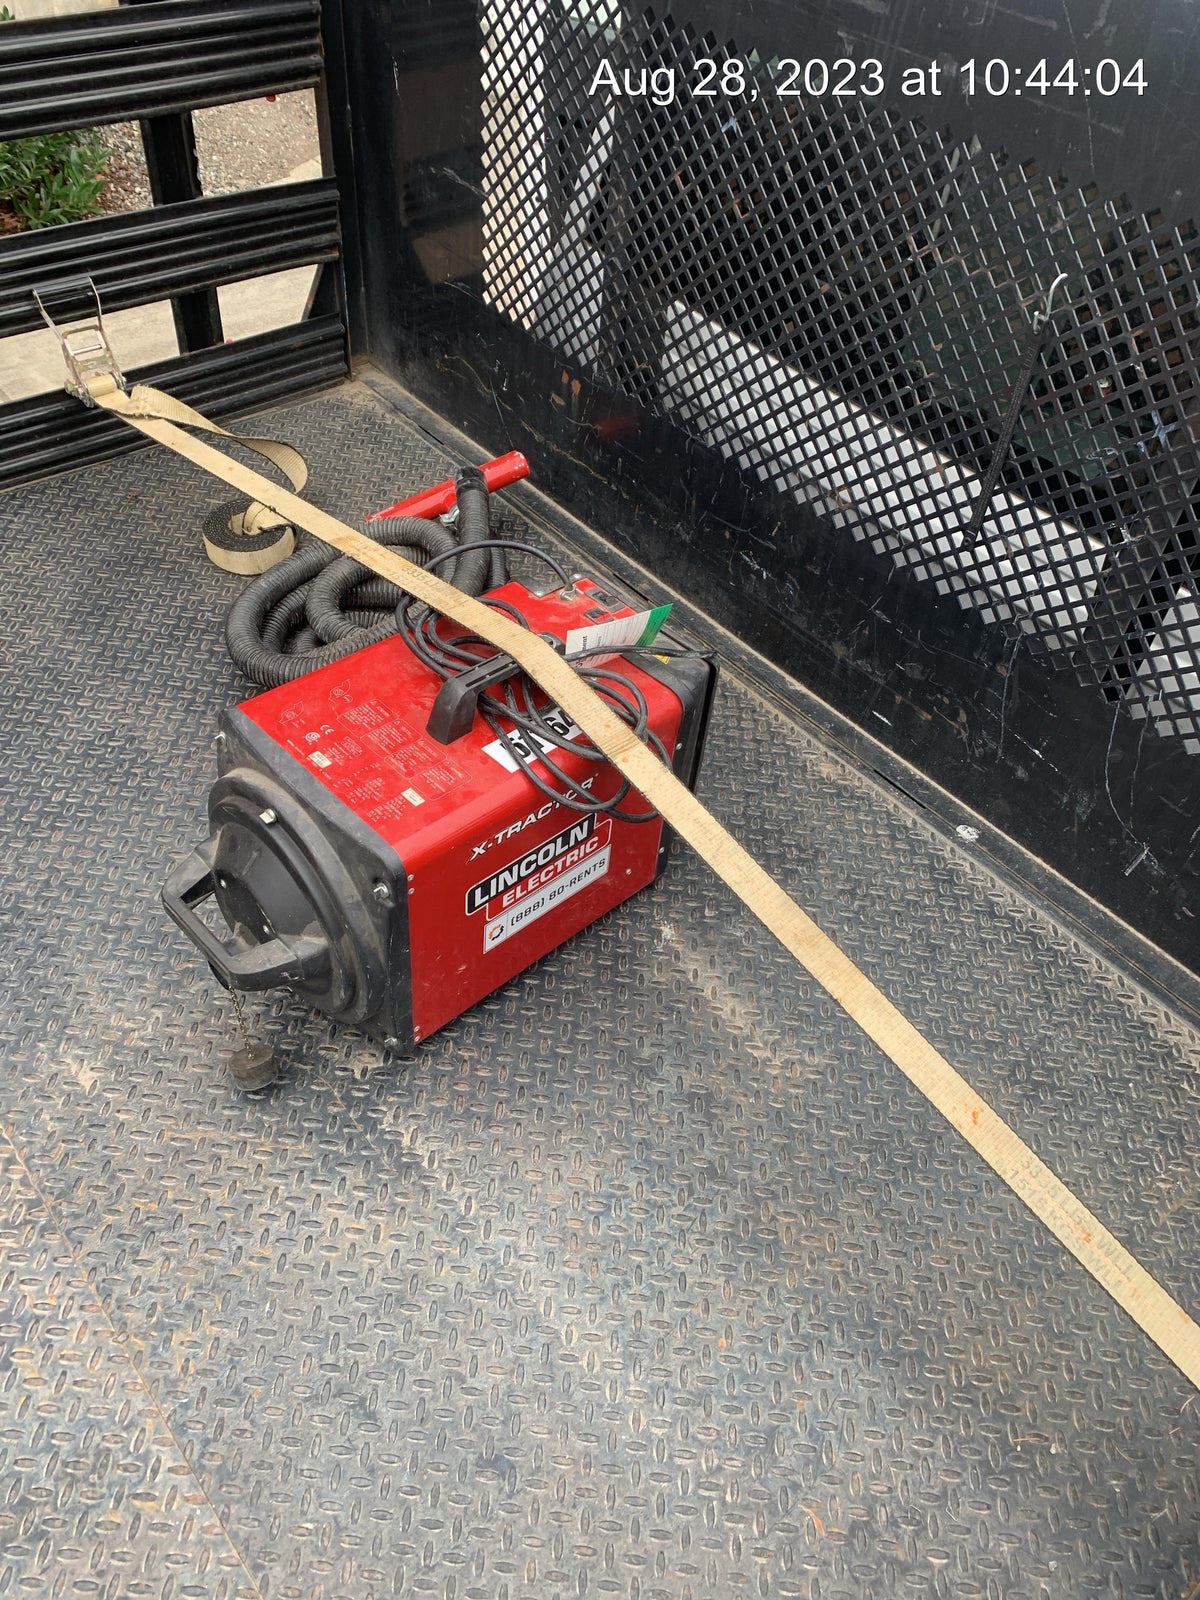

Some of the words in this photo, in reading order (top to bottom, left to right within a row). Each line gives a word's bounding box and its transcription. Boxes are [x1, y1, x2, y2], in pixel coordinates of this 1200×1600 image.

[474, 820, 589, 907] LINCOLN
[502, 836, 599, 908] ELECTRIC
[511, 897, 545, 927] (888)
[548, 858, 606, 901] 80-RENTS
